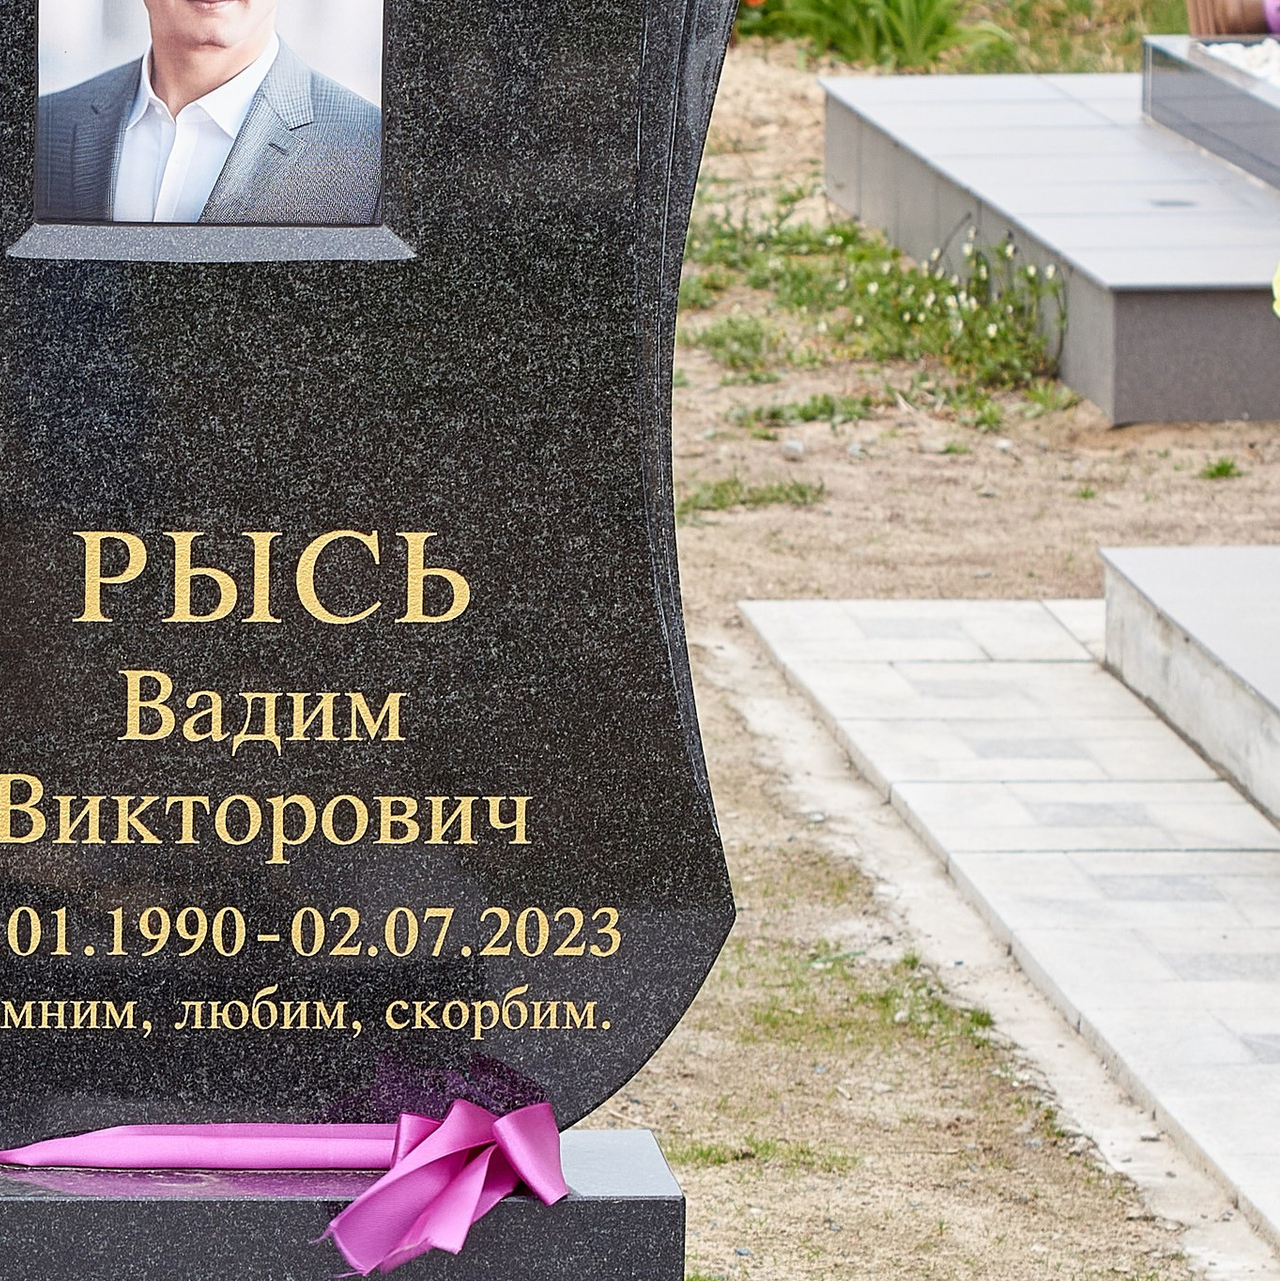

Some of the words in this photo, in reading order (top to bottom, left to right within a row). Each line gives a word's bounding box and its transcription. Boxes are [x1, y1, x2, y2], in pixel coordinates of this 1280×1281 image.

[73, 529, 472, 624] РЫСЬ
[117, 669, 408, 757] Вадим
[174, 984, 363, 1033] любим,
[385, 984, 612, 1040] скорбим.
